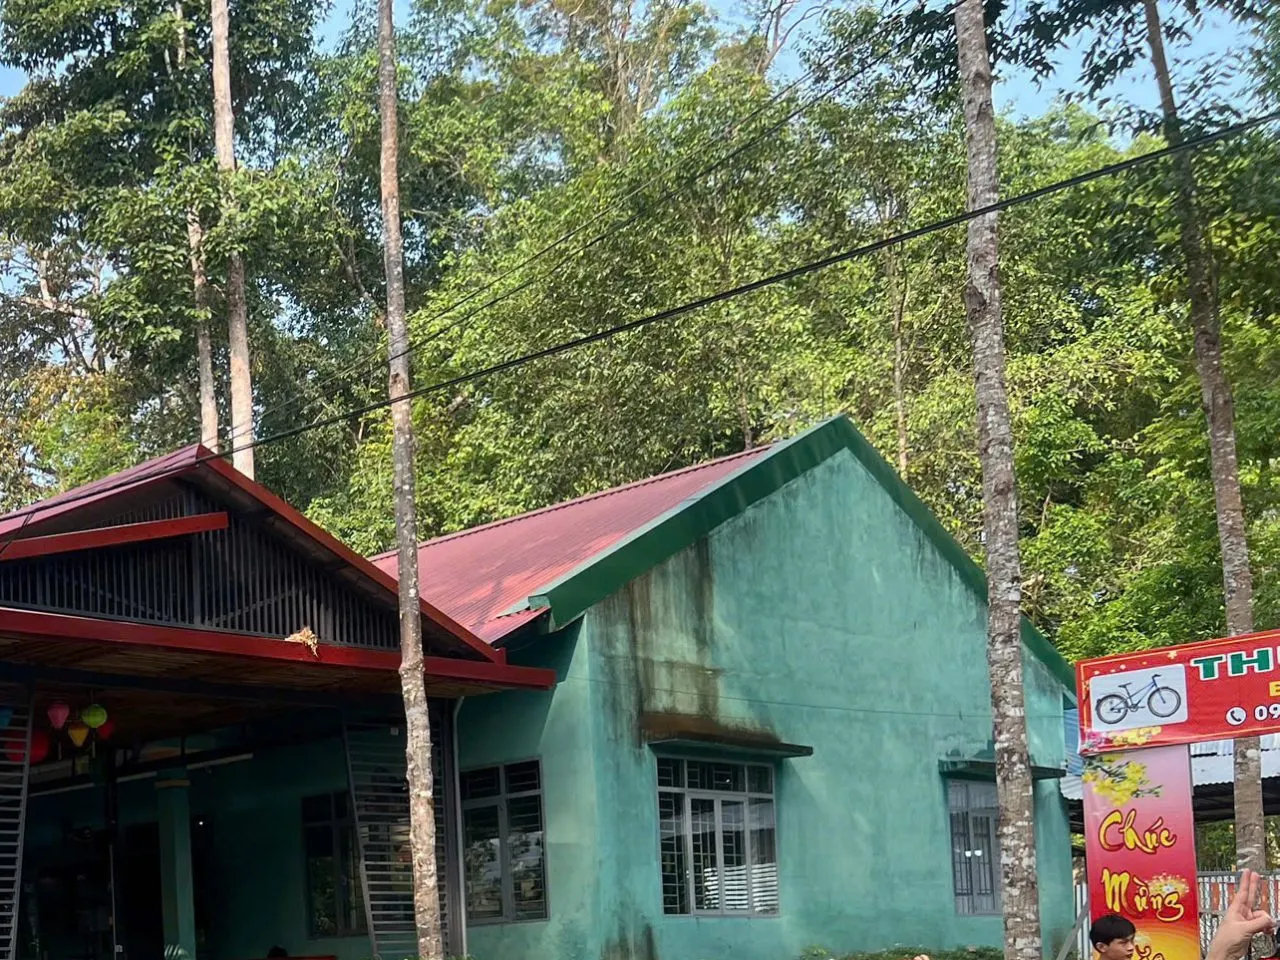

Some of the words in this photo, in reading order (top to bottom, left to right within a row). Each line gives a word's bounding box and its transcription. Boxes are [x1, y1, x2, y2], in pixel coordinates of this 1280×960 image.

[1190, 646, 1280, 681] TH
[1098, 808, 1177, 854] Chúc
[1101, 866, 1185, 922] Mừng
